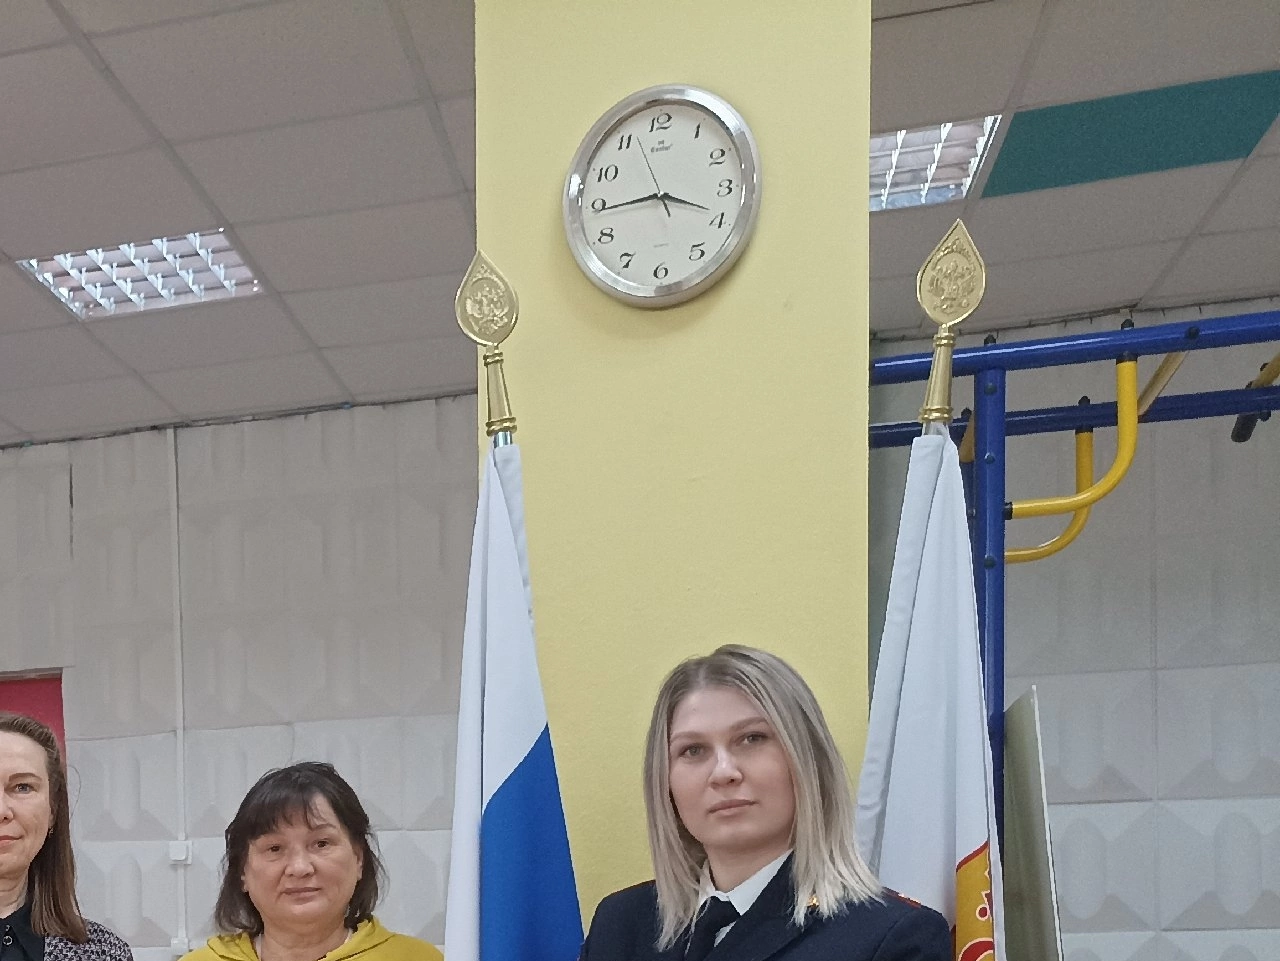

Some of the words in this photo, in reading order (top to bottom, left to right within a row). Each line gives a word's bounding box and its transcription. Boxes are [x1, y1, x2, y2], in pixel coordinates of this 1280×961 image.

[649, 113, 672, 132] 12
[694, 123, 701, 139] 1
[618, 134, 632, 150] 11
[709, 148, 726, 167] 2
[597, 164, 619, 183] 10
[717, 179, 733, 197] 3
[591, 198, 607, 214] 9
[709, 212, 726, 229] 4
[598, 227, 614, 244] 8
[689, 242, 705, 261] 5
[620, 252, 636, 269] 7
[653, 262, 669, 280] 6
